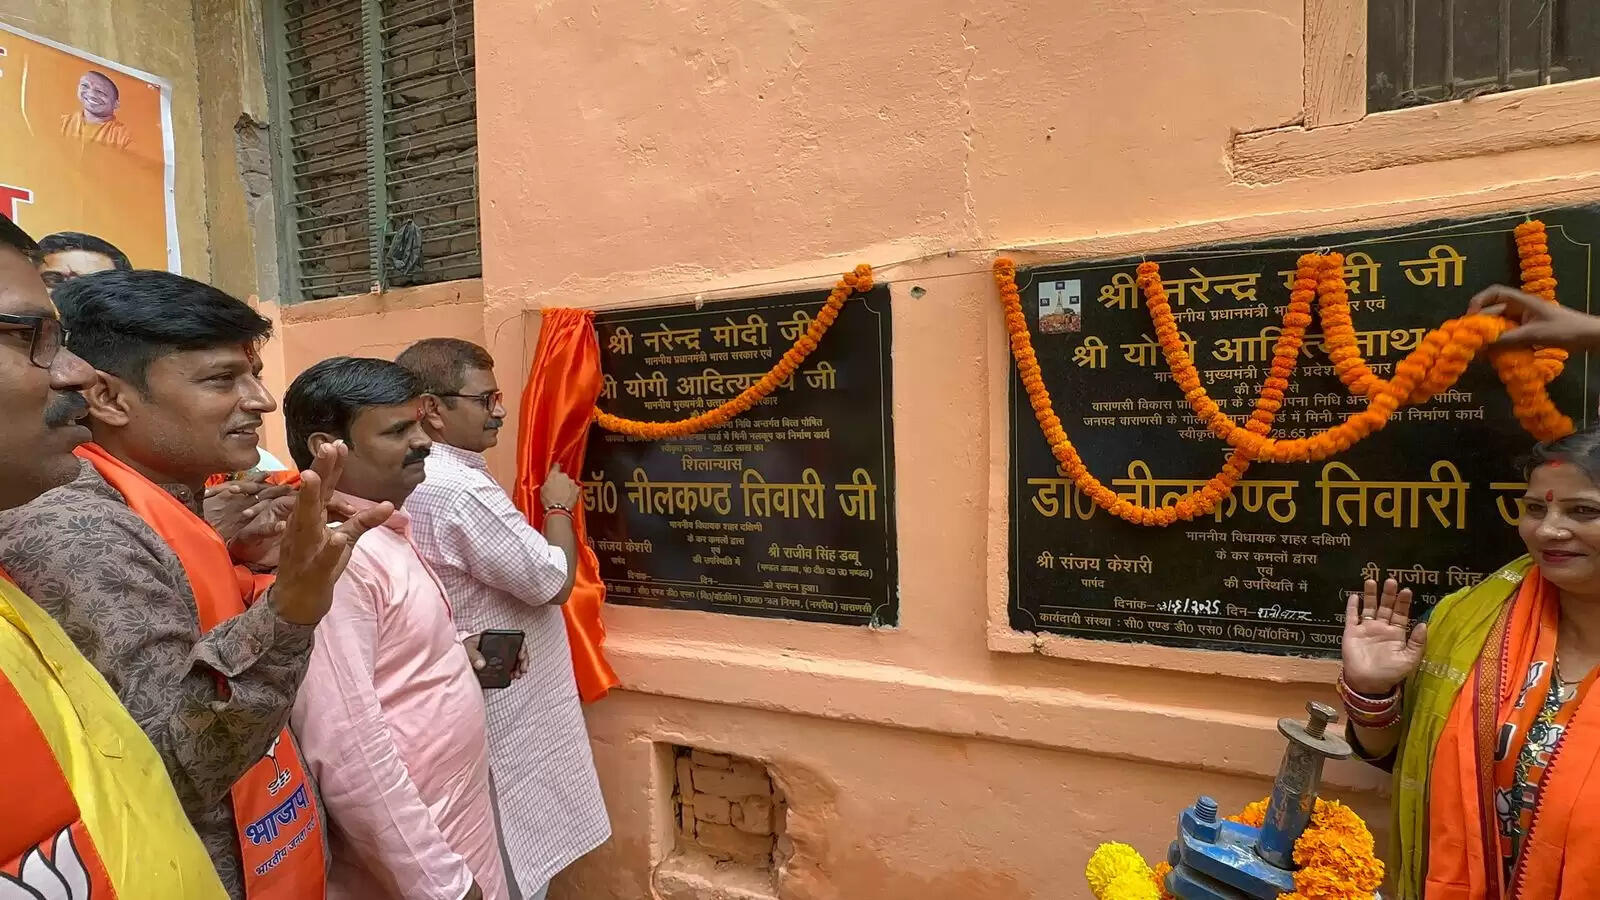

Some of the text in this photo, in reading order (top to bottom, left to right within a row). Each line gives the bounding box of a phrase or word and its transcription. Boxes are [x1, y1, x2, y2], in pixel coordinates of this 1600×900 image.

[1097, 273, 1140, 310] श्री
[1399, 244, 1467, 287] जी
[1210, 302, 1268, 321] प्रधानमंत्री
[1364, 295, 1387, 313] एवं
[608, 326, 633, 355] श्री
[641, 322, 701, 353] नरेन्द्र
[710, 316, 768, 348] मोदी
[644, 346, 772, 366] माननीय प्रधानमंत्री भारत सरकार एवं
[1071, 336, 1108, 369] श्री
[623, 371, 668, 398] योगी
[803, 361, 837, 390] जी
[1204, 365, 1257, 385] मुख्यमंत्री
[1233, 381, 1250, 396] की
[644, 398, 671, 410] माननीय
[1091, 398, 1134, 412] वाराणसी
[1137, 398, 1172, 411] विकास
[1231, 395, 1244, 408] के
[1314, 392, 1341, 406] निधि
[1083, 417, 1116, 427] जनपद
[1119, 413, 1162, 427] वाराणसी
[1165, 413, 1177, 425] के
[1290, 410, 1301, 423] में
[1305, 410, 1333, 423] मिनी
[1407, 407, 1449, 421] निर्माण
[1455, 405, 1485, 421] कार्य
[787, 428, 812, 440] निर्माण
[681, 454, 742, 471] शिलान्यास
[625, 467, 732, 515] नीलकण्ठ
[740, 468, 825, 519] तिवारी
[835, 467, 877, 521] जी
[1315, 460, 1470, 530] तिवारी
[598, 537, 622, 552] संजय
[625, 538, 653, 553] केशरी
[1185, 529, 1351, 547] माननीय विधायक शहर दक्षिणी
[768, 542, 780, 559] श्री
[783, 543, 812, 560] राजीव
[815, 545, 836, 562] सिंह
[1036, 550, 1153, 574] श्री संजय केशरी
[1215, 548, 1317, 565] के कर कमलों द्वारा
[1257, 564, 1274, 577] एवं
[1360, 562, 1380, 582] श्री
[1386, 563, 1440, 585] राजीव
[1223, 575, 1309, 593] की उपस्थिति में
[839, 602, 873, 615] वाराणसी
[1040, 611, 1081, 625] कार्यदायी
[1084, 613, 1111, 627] संस्था
[1148, 621, 1170, 632] एण्ड
[255, 849, 288, 876] भारतीय
